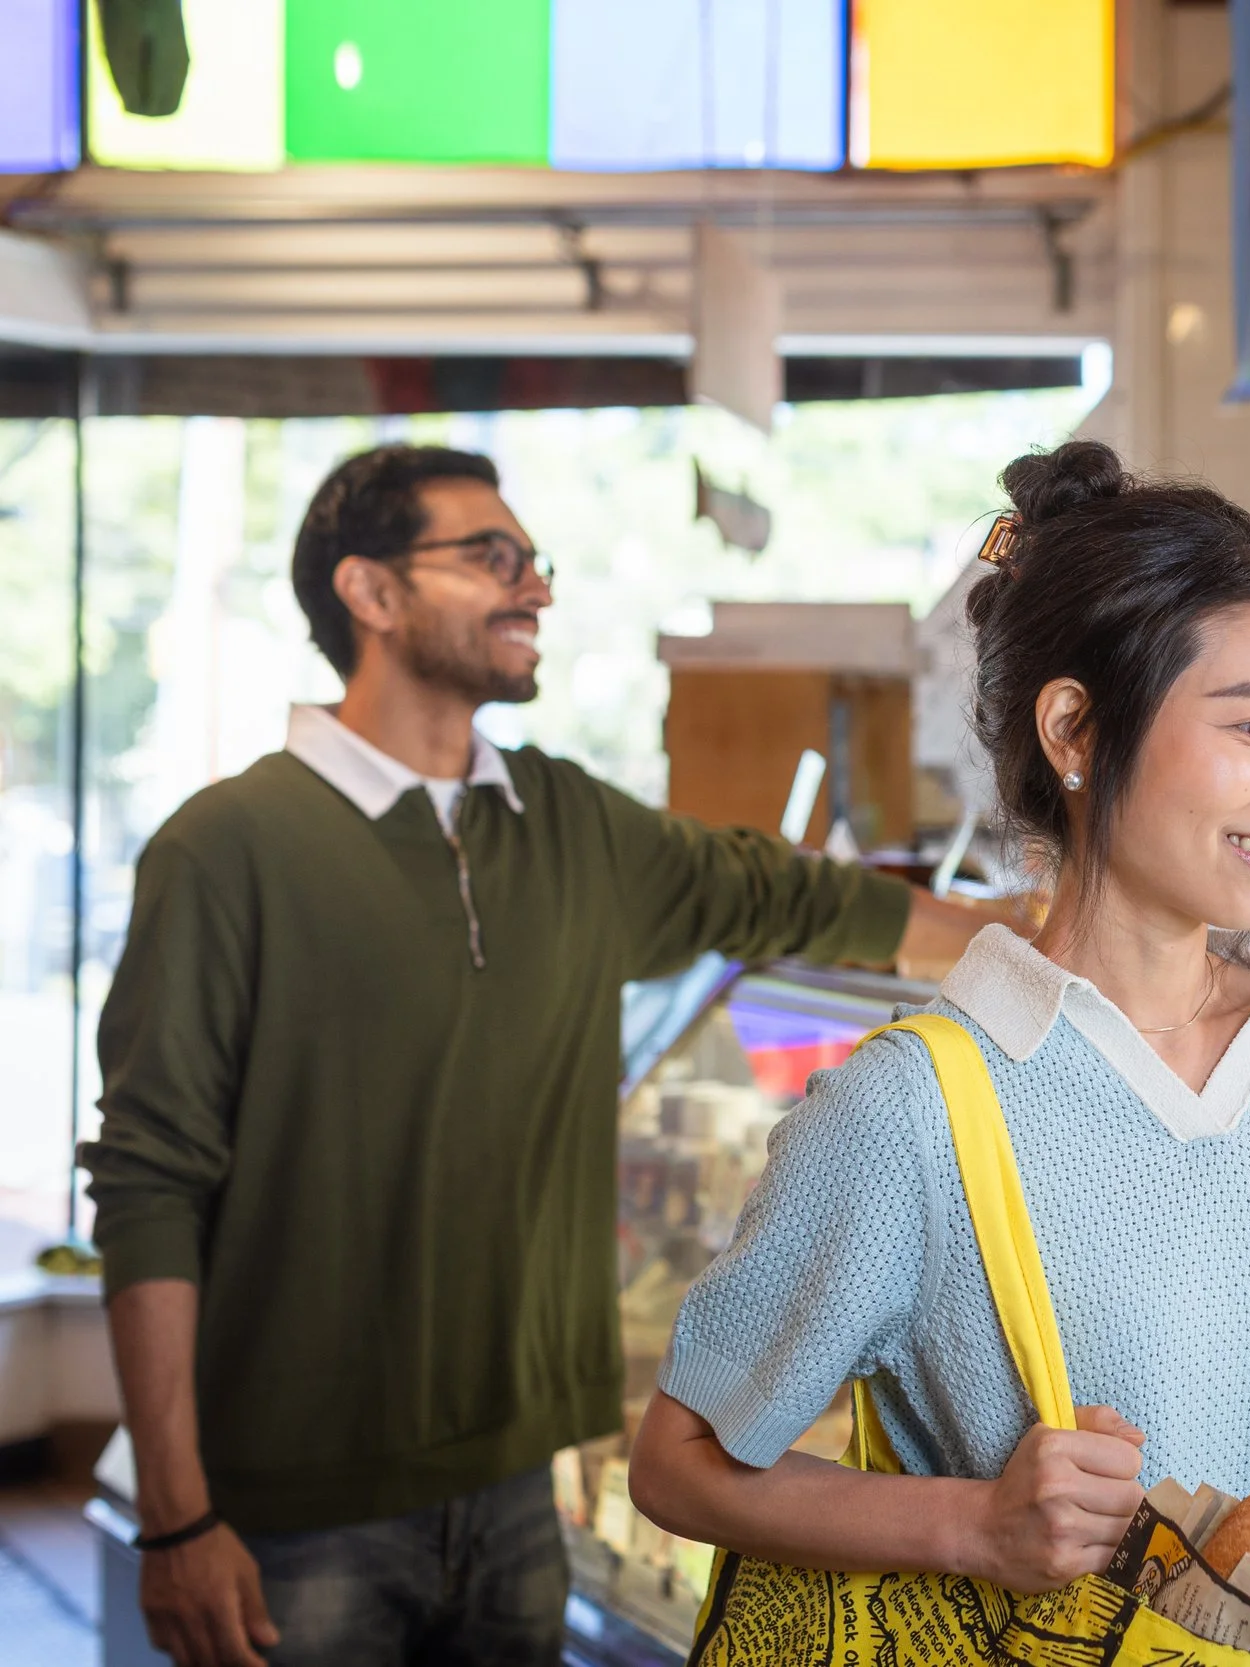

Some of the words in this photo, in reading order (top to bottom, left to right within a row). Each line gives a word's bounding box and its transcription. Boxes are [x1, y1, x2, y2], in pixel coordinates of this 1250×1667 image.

[839, 1591, 859, 1643] barack
[888, 1588, 907, 1619] them
[904, 1614, 912, 1630] in
[910, 1629, 933, 1664] detail
[900, 1580, 925, 1621] tedious
[919, 1619, 946, 1658] person
[914, 1572, 934, 1601] their
[931, 1601, 957, 1646] reubens
[953, 1644, 970, 1665] are
